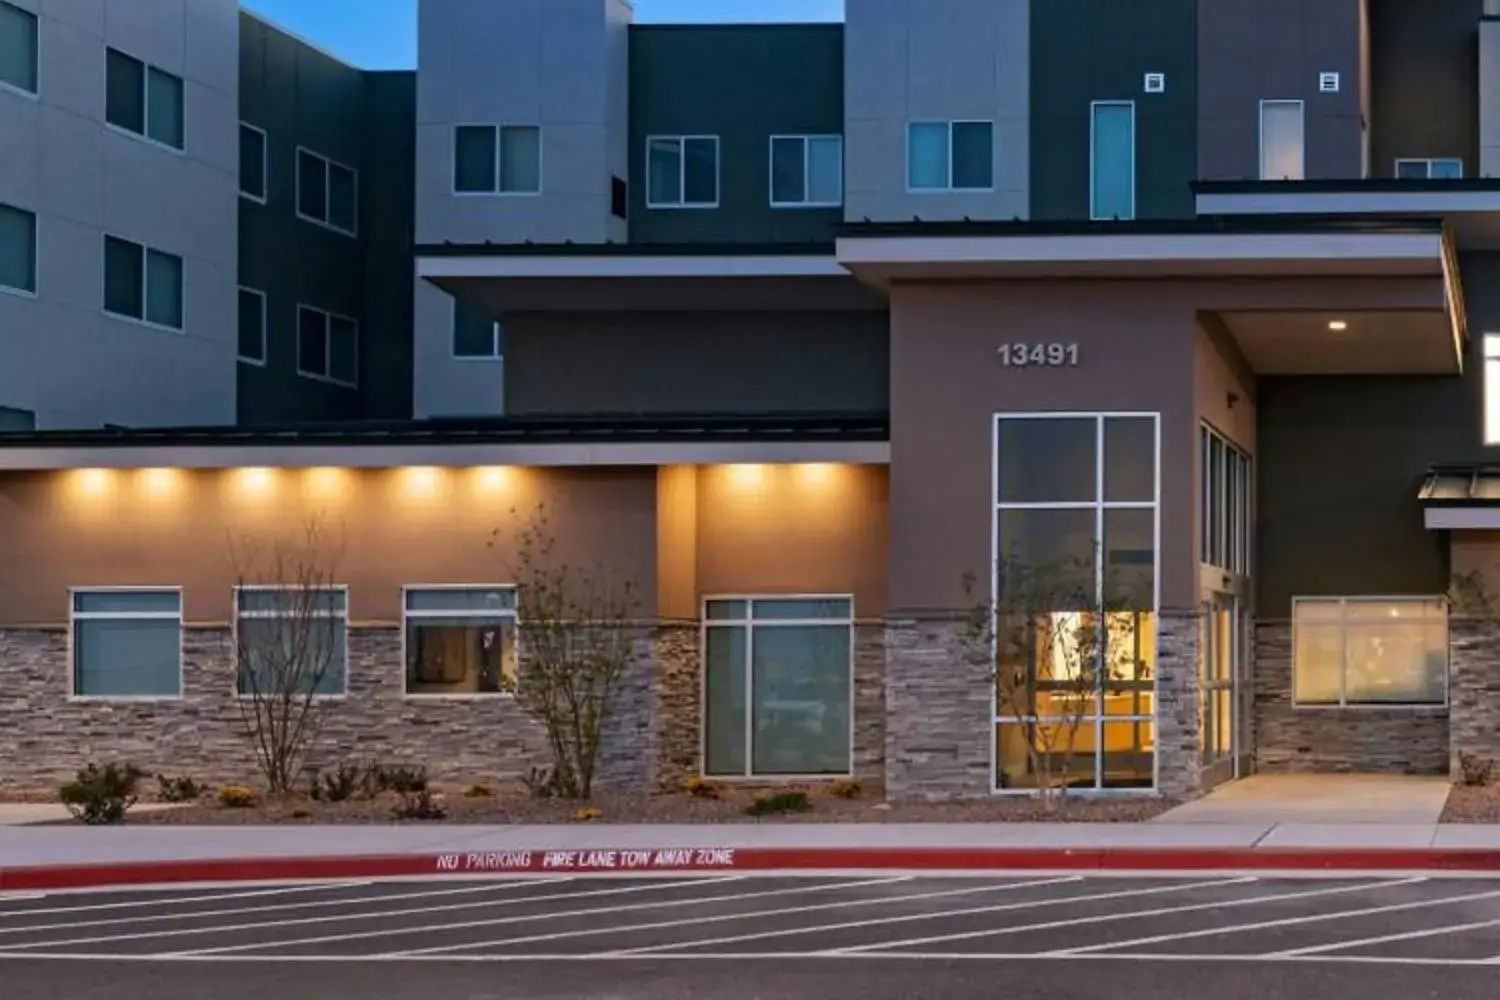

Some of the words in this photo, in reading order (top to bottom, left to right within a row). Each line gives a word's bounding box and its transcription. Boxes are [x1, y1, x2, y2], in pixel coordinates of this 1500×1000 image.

[997, 343, 1078, 365] 13491
[436, 854, 459, 869] NO
[466, 851, 531, 869] PARKING
[543, 851, 576, 867] FIRE
[579, 851, 616, 867] LANE
[620, 851, 651, 867] TOW
[654, 849, 693, 865] AWAY
[696, 849, 733, 865] ZONE
